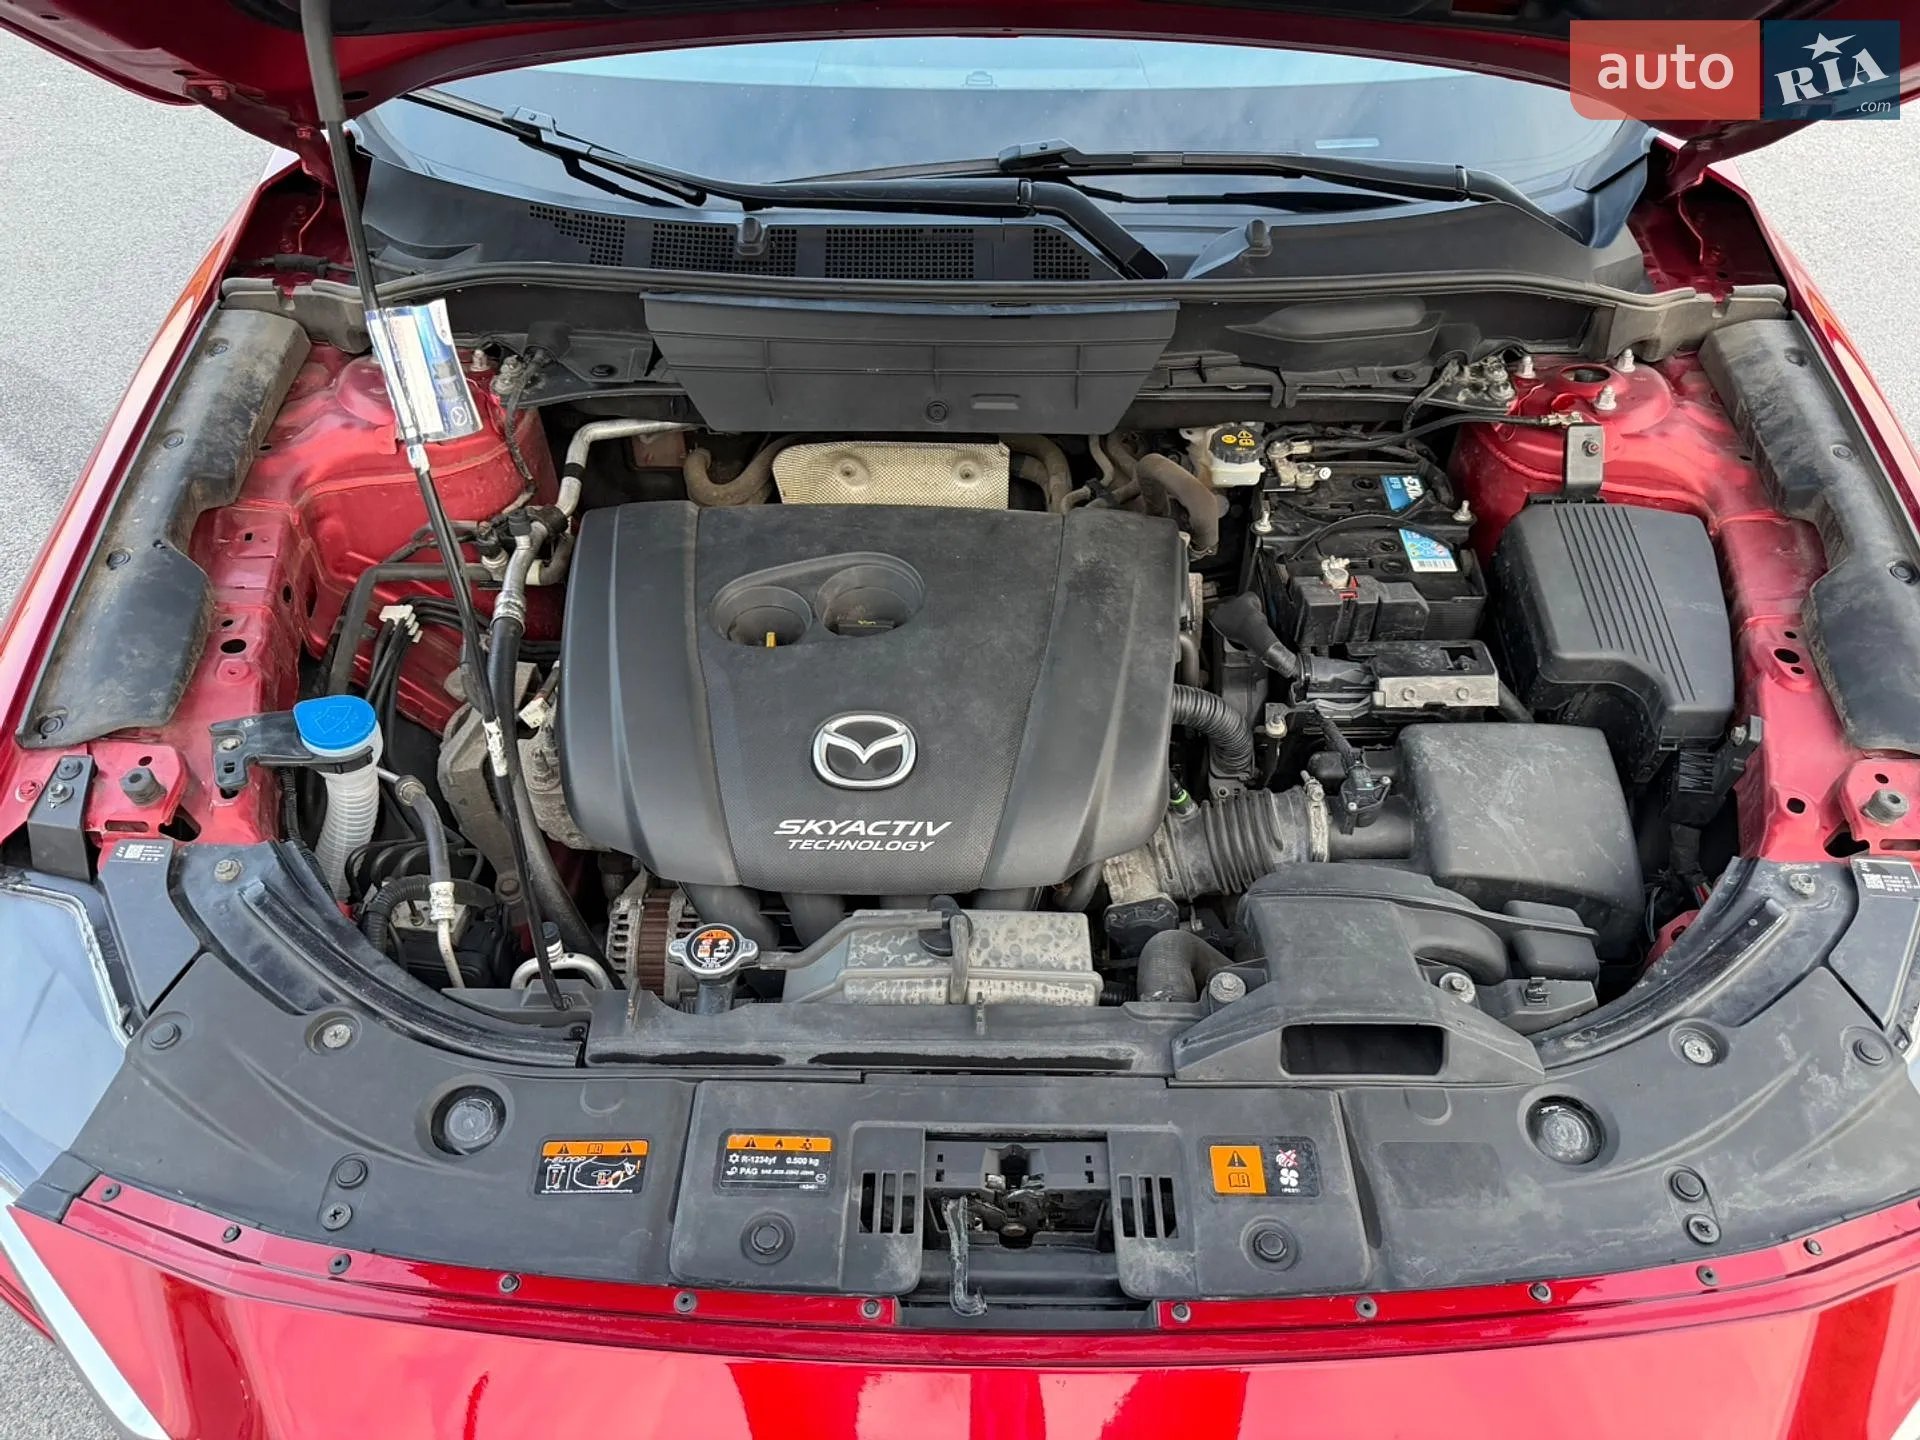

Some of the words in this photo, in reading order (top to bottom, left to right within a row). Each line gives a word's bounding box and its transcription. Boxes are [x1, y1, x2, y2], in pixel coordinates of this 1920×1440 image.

[773, 819, 953, 837] SKYACTIV
[788, 839, 936, 852] TECHNOLOGY
[809, 1157, 820, 1167] kg
[739, 1166, 759, 1176] PAG
